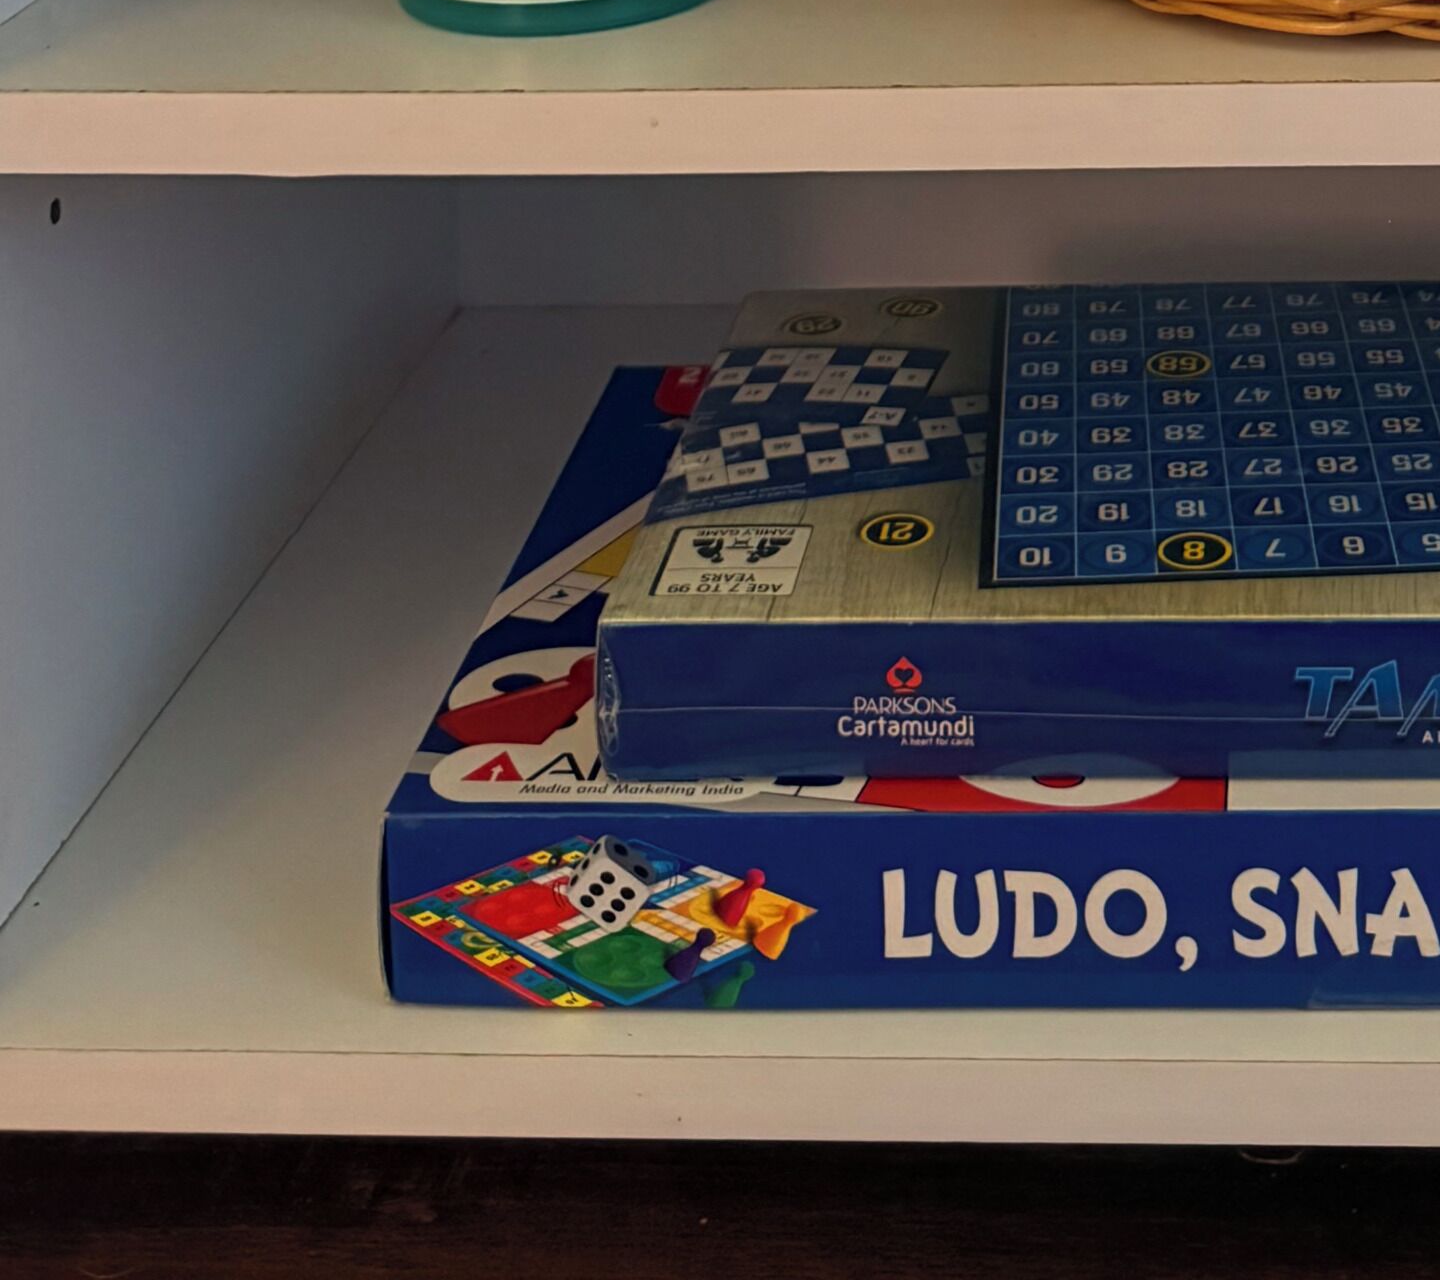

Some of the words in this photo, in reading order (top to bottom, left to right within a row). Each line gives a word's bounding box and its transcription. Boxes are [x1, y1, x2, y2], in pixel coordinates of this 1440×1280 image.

[1157, 325, 1195, 341] 68
[1225, 323, 1262, 338] 67
[1291, 320, 1329, 336] 66
[1358, 318, 1396, 334] 65
[1022, 330, 1058, 345] 70
[1088, 328, 1128, 343] 69
[1158, 356, 1199, 373] 58
[1229, 354, 1266, 370] 57
[1296, 351, 1336, 367] 56
[1365, 349, 1405, 365] 55
[1020, 361, 1060, 377] 60
[1090, 359, 1128, 375] 59
[1162, 389, 1201, 406] 48
[1233, 387, 1271, 404] 47
[1303, 385, 1342, 401] 46
[1373, 382, 1413, 399] 45
[1019, 394, 1059, 411] 50
[1090, 392, 1131, 409] 49
[1163, 423, 1205, 441] 38
[1238, 421, 1278, 439] 37
[1309, 419, 1351, 436] 36
[1381, 416, 1423, 434] 35
[1018, 429, 1059, 447] 40
[1091, 426, 1132, 444] 39
[1167, 460, 1209, 479] 28
[1243, 458, 1283, 476] 27
[1316, 456, 1359, 474] 26
[1391, 453, 1433, 472] 25
[1016, 466, 1059, 484] 30
[1092, 463, 1133, 482] 29
[1175, 499, 1207, 518] 18
[1253, 496, 1284, 516] 17
[1328, 495, 1362, 513] 16
[1405, 492, 1438, 511] 15
[1015, 505, 1058, 525] 20
[1098, 502, 1130, 522] 19
[879, 521, 916, 541] 21
[1105, 544, 1127, 564] 9
[1183, 540, 1205, 561] 8
[1265, 538, 1286, 558] 7
[1342, 536, 1365, 555] 6
[1019, 547, 1052, 567] 10
[701, 572, 755, 582] YEARS
[667, 583, 692, 593] 99
[696, 583, 722, 593] TO
[728, 583, 740, 593] 7
[746, 583, 783, 593] AGE
[853, 695, 957, 715] PARKSONS
[837, 715, 976, 737] Cartamundi
[1421, 730, 1433, 745] A
[519, 782, 573, 794] Media
[575, 782, 609, 794] and
[611, 783, 696, 797] Marketing
[701, 783, 745, 795] India
[882, 868, 1198, 971] LUDO,
